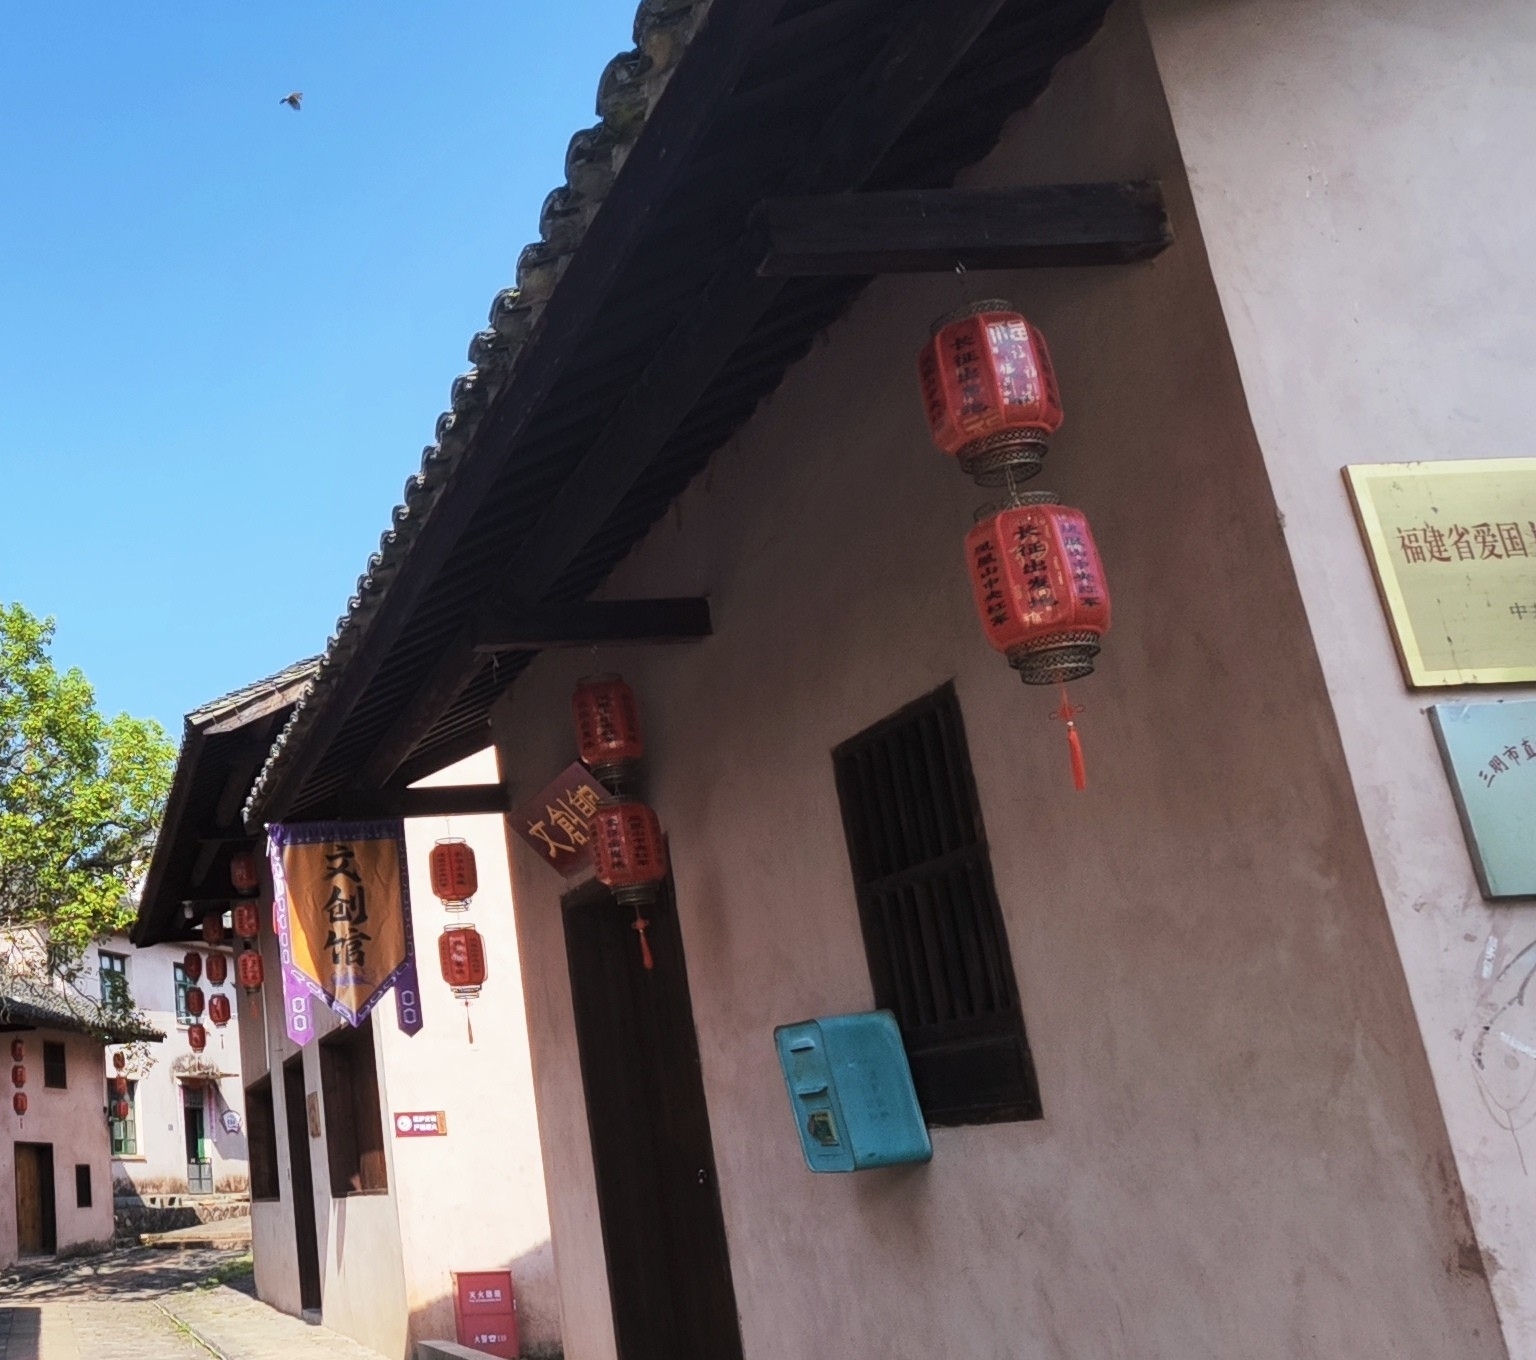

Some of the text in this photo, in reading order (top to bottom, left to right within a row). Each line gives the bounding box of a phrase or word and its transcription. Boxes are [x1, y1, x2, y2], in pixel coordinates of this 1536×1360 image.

[1013, 524, 1060, 608] 长征出发地
[1396, 521, 1536, 564] 福建省爱国
[323, 844, 372, 967] 文创馆
